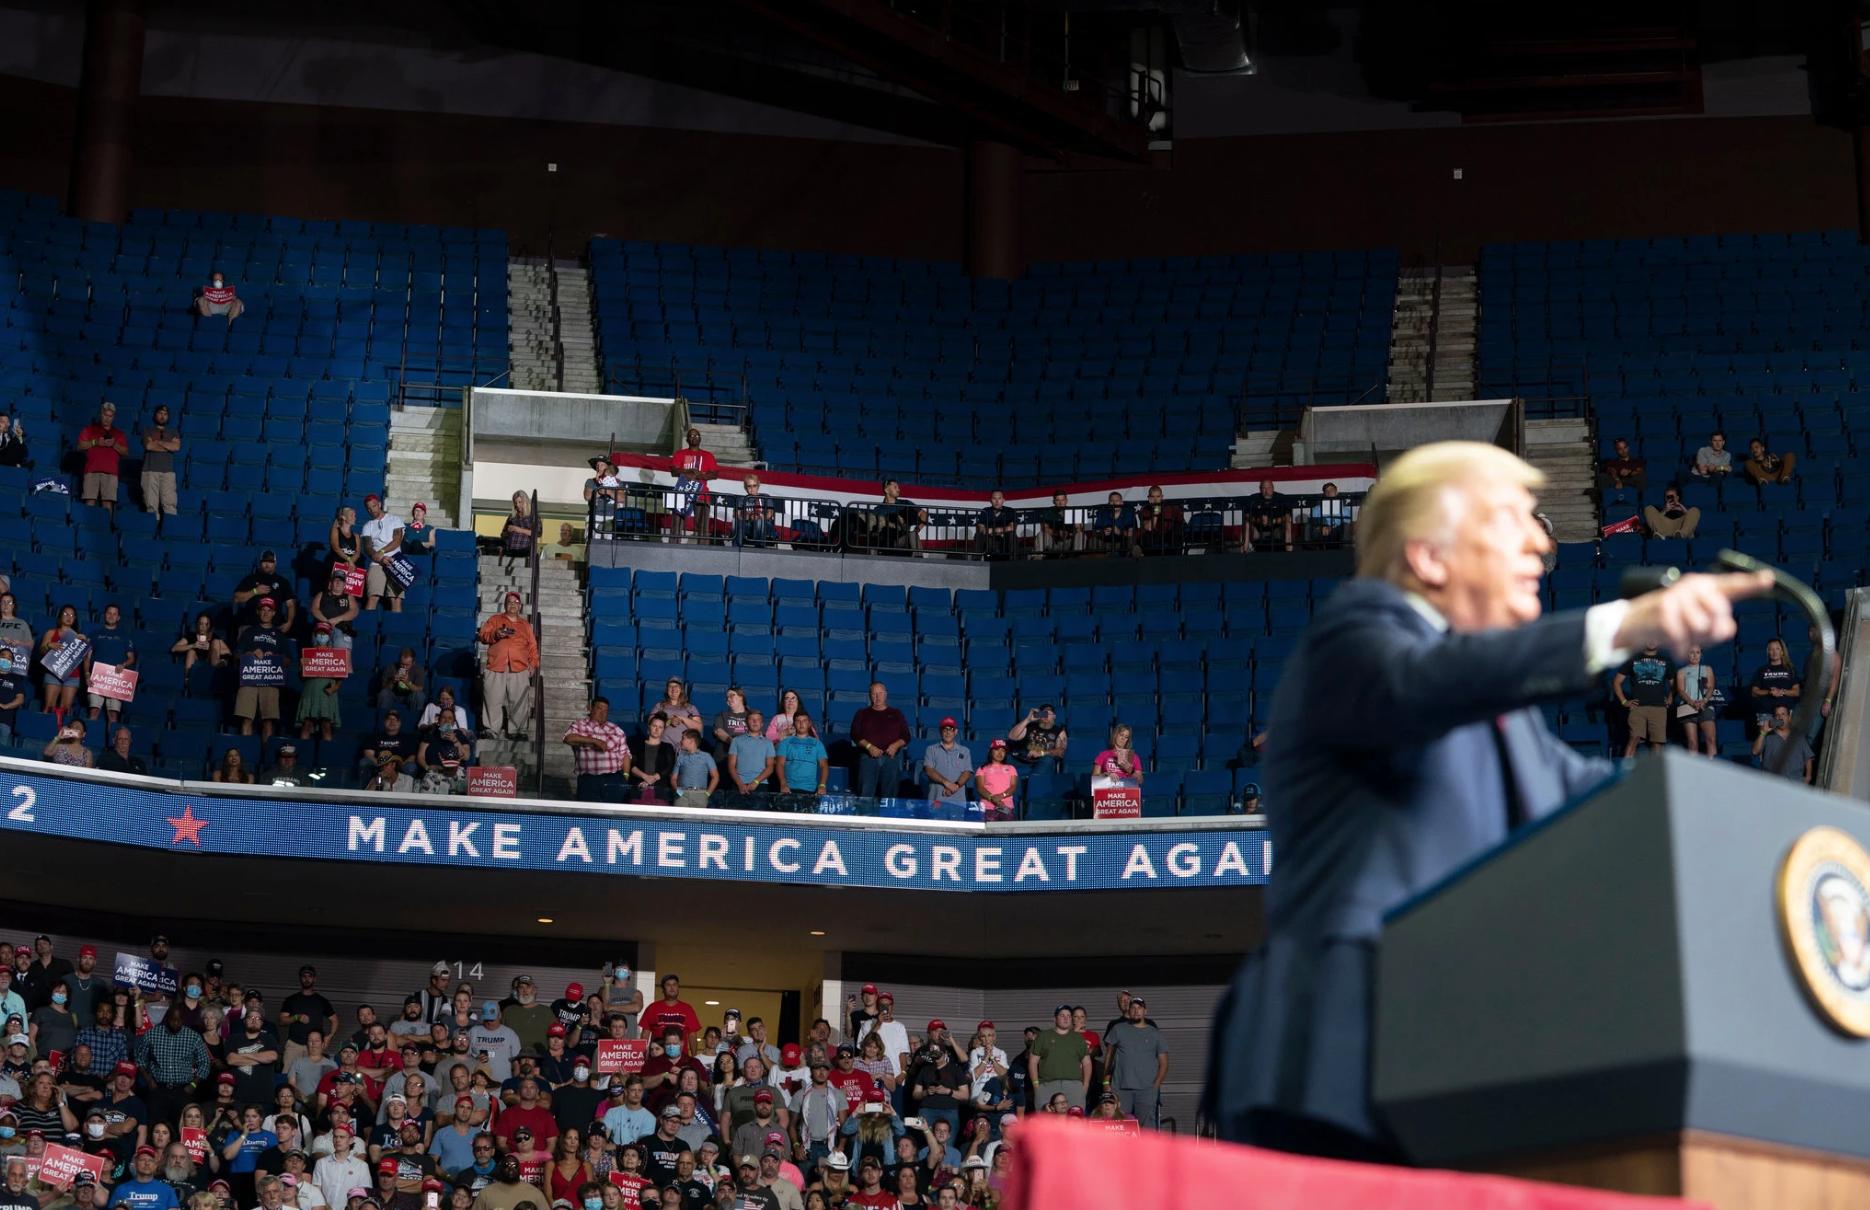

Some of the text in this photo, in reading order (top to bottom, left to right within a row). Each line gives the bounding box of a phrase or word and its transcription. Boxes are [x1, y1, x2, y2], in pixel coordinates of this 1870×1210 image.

[391, 558, 415, 583] MERICA
[52, 638, 82, 671] AMERICA
[72, 641, 88, 661] AGAIN
[308, 658, 346, 666] MERICA
[242, 665, 283, 674] AMERICA
[93, 674, 133, 689] AMERICA
[112, 686, 132, 696] AGAIN
[470, 779, 514, 788] AMERICA
[7, 785, 36, 822] 2
[1096, 800, 1138, 808] AMERICA
[347, 815, 1273, 882] MAKE AMERICA GREAT AGAI
[130, 961, 150, 970] MAKE
[453, 961, 485, 980] 14
[116, 966, 158, 982] AMERICA
[115, 974, 138, 984] GREAT
[138, 979, 157, 989] AGAIN
[558, 1009, 580, 1021] TRUMP
[62, 1154, 86, 1166] MAKE
[43, 1168, 69, 1180] GREAT
[622, 1180, 641, 1188] MAKE
[129, 1191, 159, 1201] Trump
